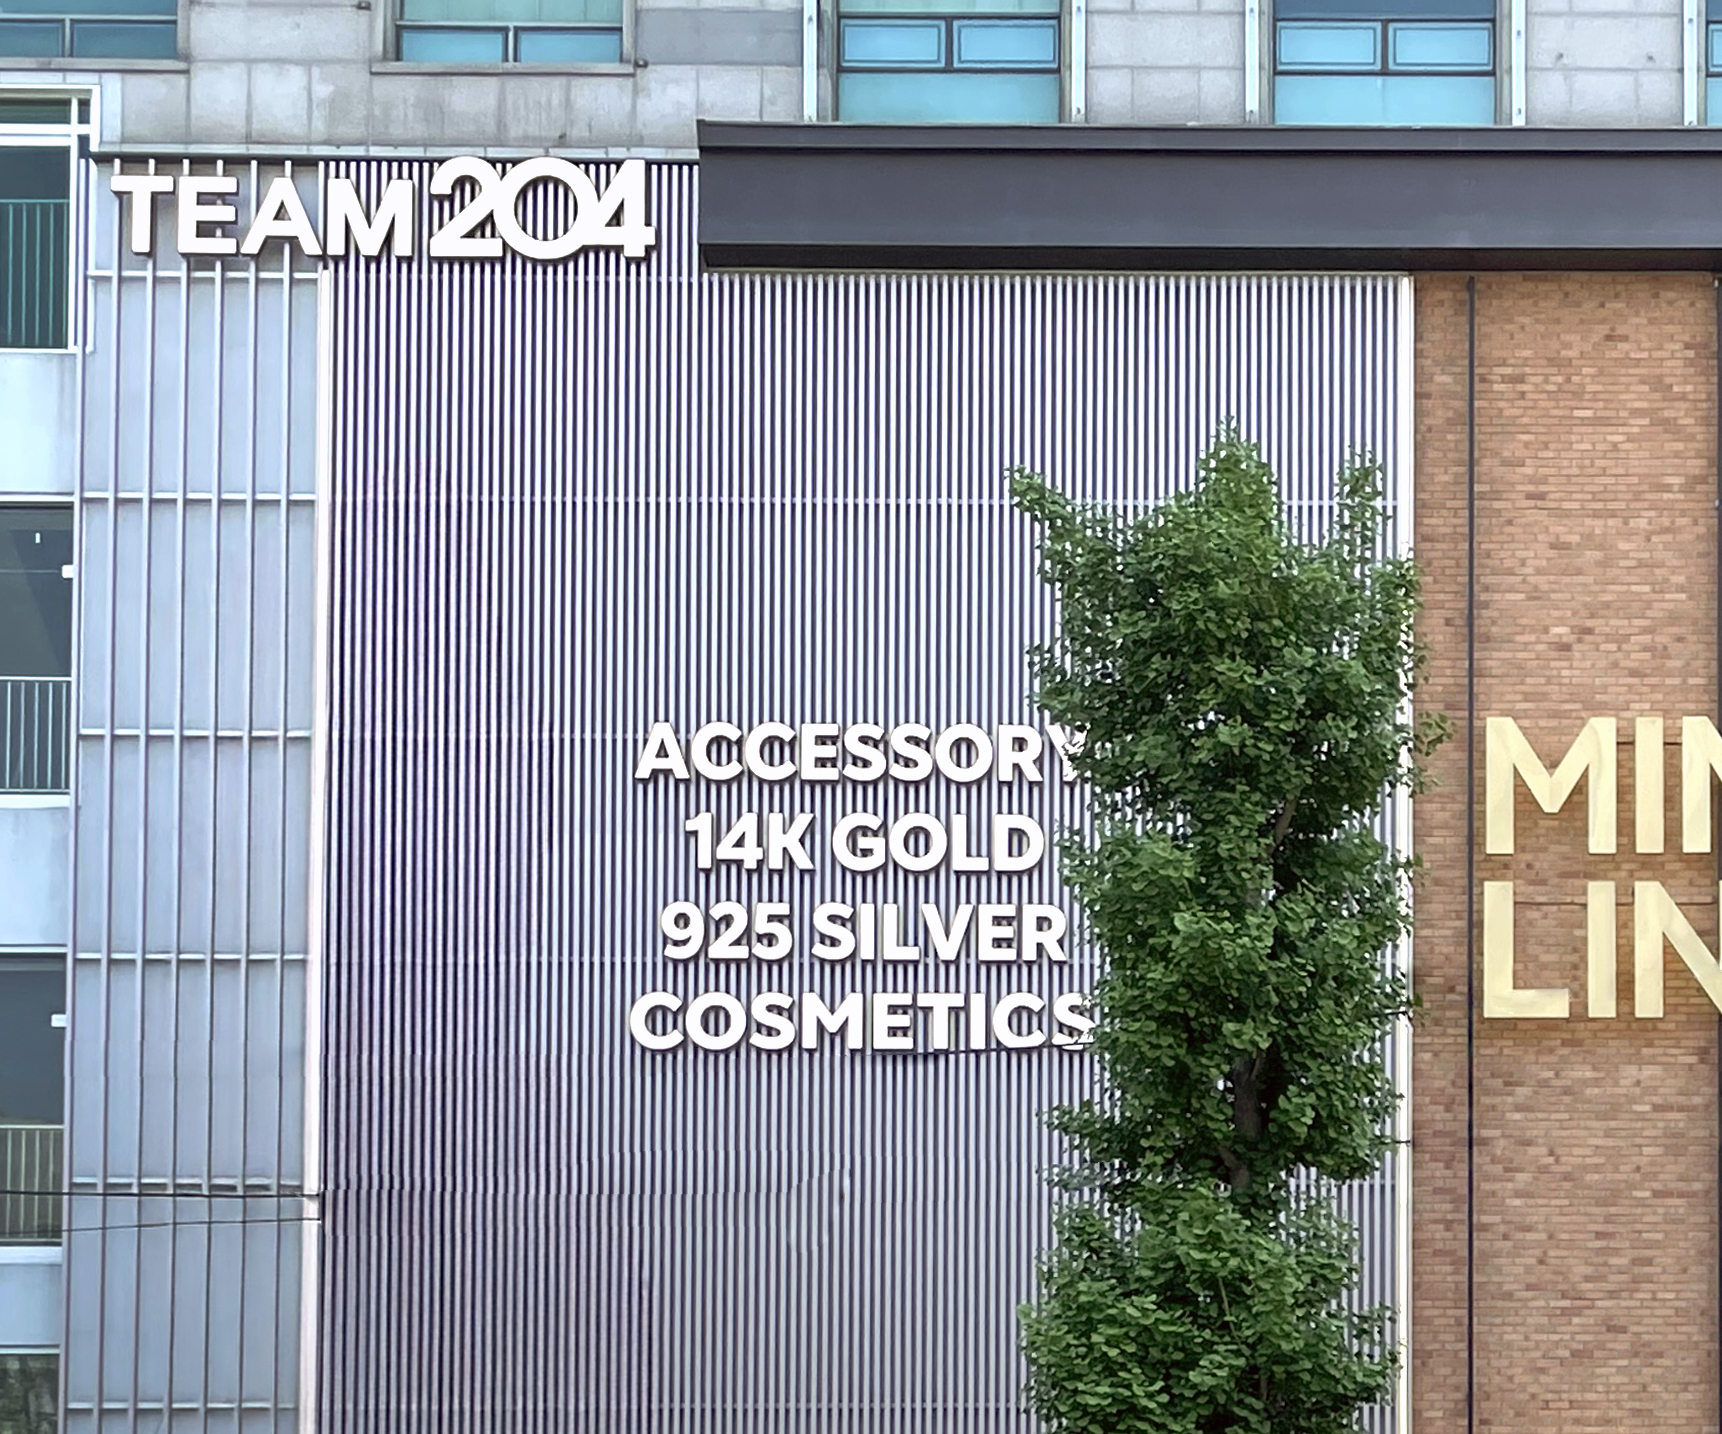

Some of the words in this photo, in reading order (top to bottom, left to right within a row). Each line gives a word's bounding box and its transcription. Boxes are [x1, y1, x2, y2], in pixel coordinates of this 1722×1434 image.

[634, 721, 1090, 783] ACCESSORY
[685, 811, 814, 872] 14K
[831, 812, 1045, 872] GOLD
[661, 901, 794, 963] 925
[811, 902, 1069, 963] SILVER
[629, 990, 1096, 1052] COSMETICS
